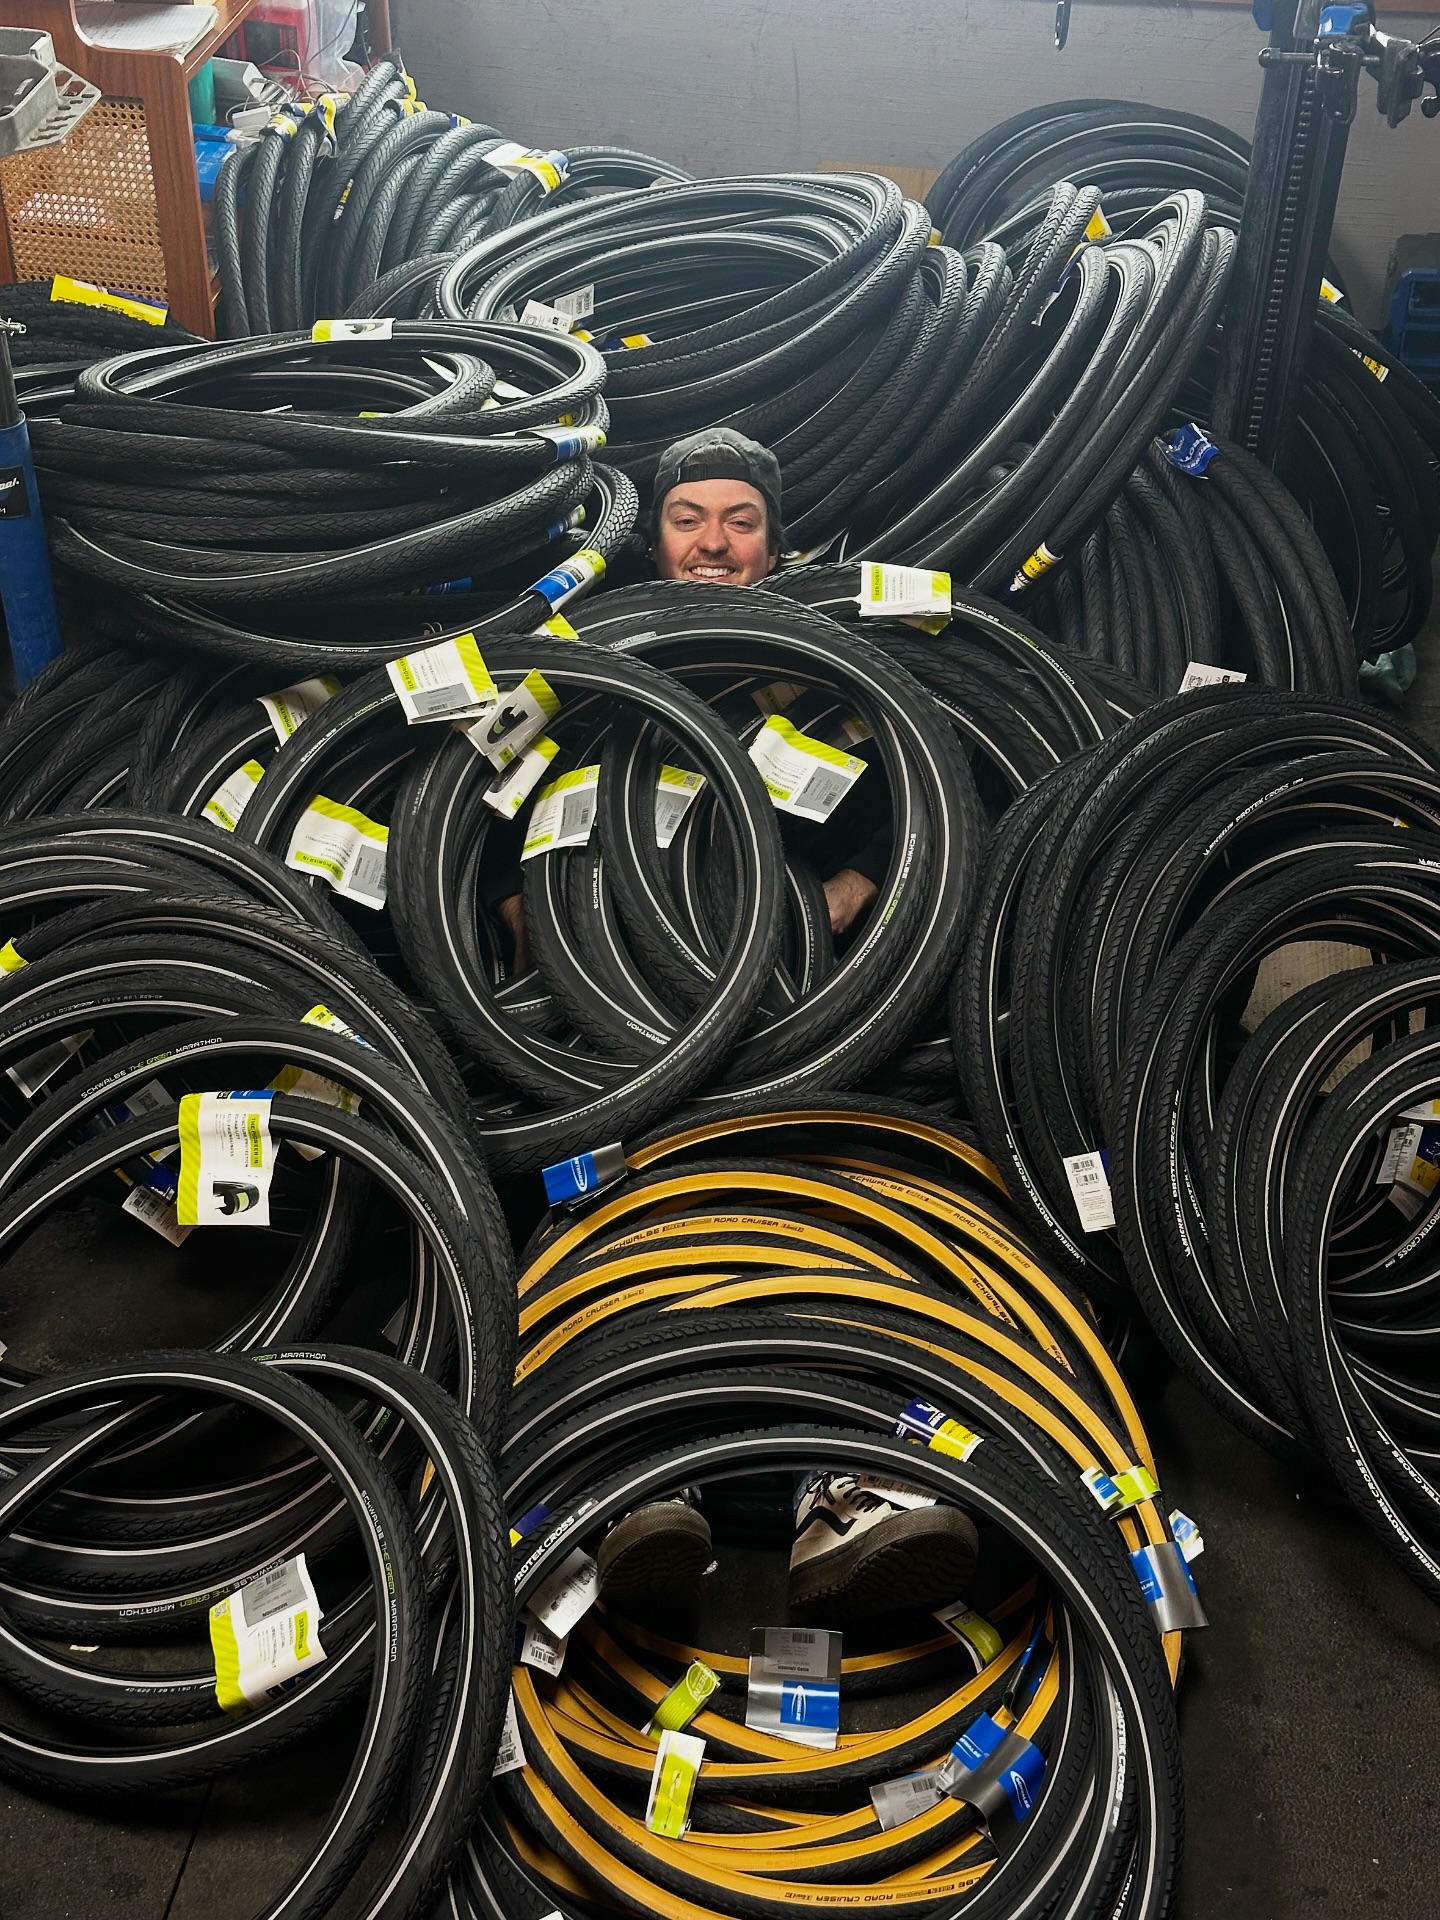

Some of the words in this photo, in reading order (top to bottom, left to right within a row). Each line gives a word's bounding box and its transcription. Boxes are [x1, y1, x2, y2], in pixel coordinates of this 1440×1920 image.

[1040, 649, 1075, 685] MARATHON
[1236, 797, 1265, 822] PROTEK
[1264, 782, 1290, 801] CROSS
[902, 833, 917, 880] SCHWALBE
[853, 926, 885, 969] MARATHON
[81, 1069, 127, 1099] SCHWALBE
[127, 1060, 146, 1073] THE
[175, 1036, 223, 1054] MARATHON
[1170, 1150, 1178, 1198] PROTEK
[849, 1174, 904, 1192] SCHWALBE
[953, 1211, 977, 1228] ROAD
[977, 1227, 1010, 1252] CRUISER
[1028, 1189, 1053, 1228] PROTEK
[606, 1227, 660, 1252] SCHWALBE
[741, 1217, 779, 1227] CRUISER
[1397, 1236, 1421, 1260] CROSS
[562, 1316, 584, 1335] ROAD
[585, 1297, 620, 1318] CRUISER
[280, 1351, 327, 1360] MARATHON
[1355, 1459, 1380, 1498] CROSS
[1391, 1449, 1423, 1484] CROSS
[360, 1490, 385, 1540] SCHWALBE
[543, 1515, 576, 1548] CROSS
[1376, 1497, 1410, 1543] PROTEK
[380, 1542, 391, 1560] THE
[1410, 1545, 1440, 1582] ICHELIN
[233, 1557, 285, 1590] SCHWALBE
[386, 1563, 395, 1595] GREEN
[119, 1603, 175, 1617] MARATHON
[179, 1595, 211, 1608] GREEN
[212, 1587, 231, 1598] THE
[390, 1599, 398, 1662] MARATHON
[816, 1894, 861, 1902] CRUISER
[863, 1893, 894, 1901] ROAD
